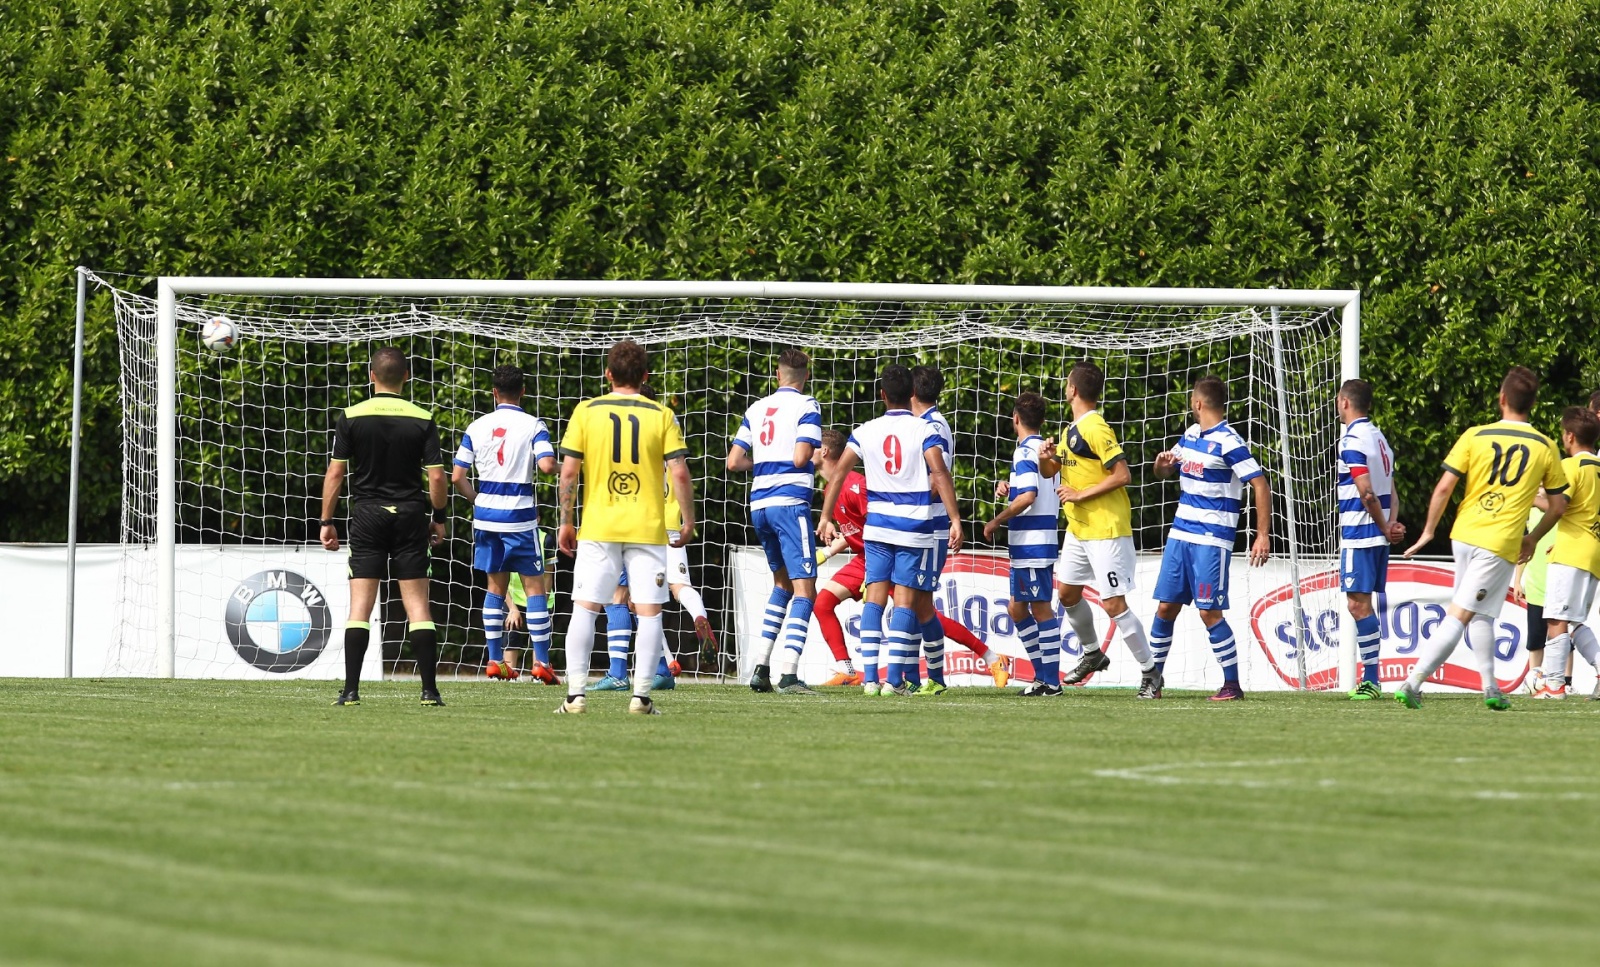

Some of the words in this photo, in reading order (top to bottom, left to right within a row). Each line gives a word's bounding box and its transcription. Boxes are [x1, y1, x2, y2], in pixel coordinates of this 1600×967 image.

[609, 412, 640, 464] 11
[760, 407, 778, 446] 5
[492, 427, 507, 466] 7
[883, 434, 902, 475] 9
[1488, 441, 1530, 487] 10
[234, 571, 323, 607] BMW
[1107, 571, 1119, 588] 6
[1198, 583, 1212, 599] 11
